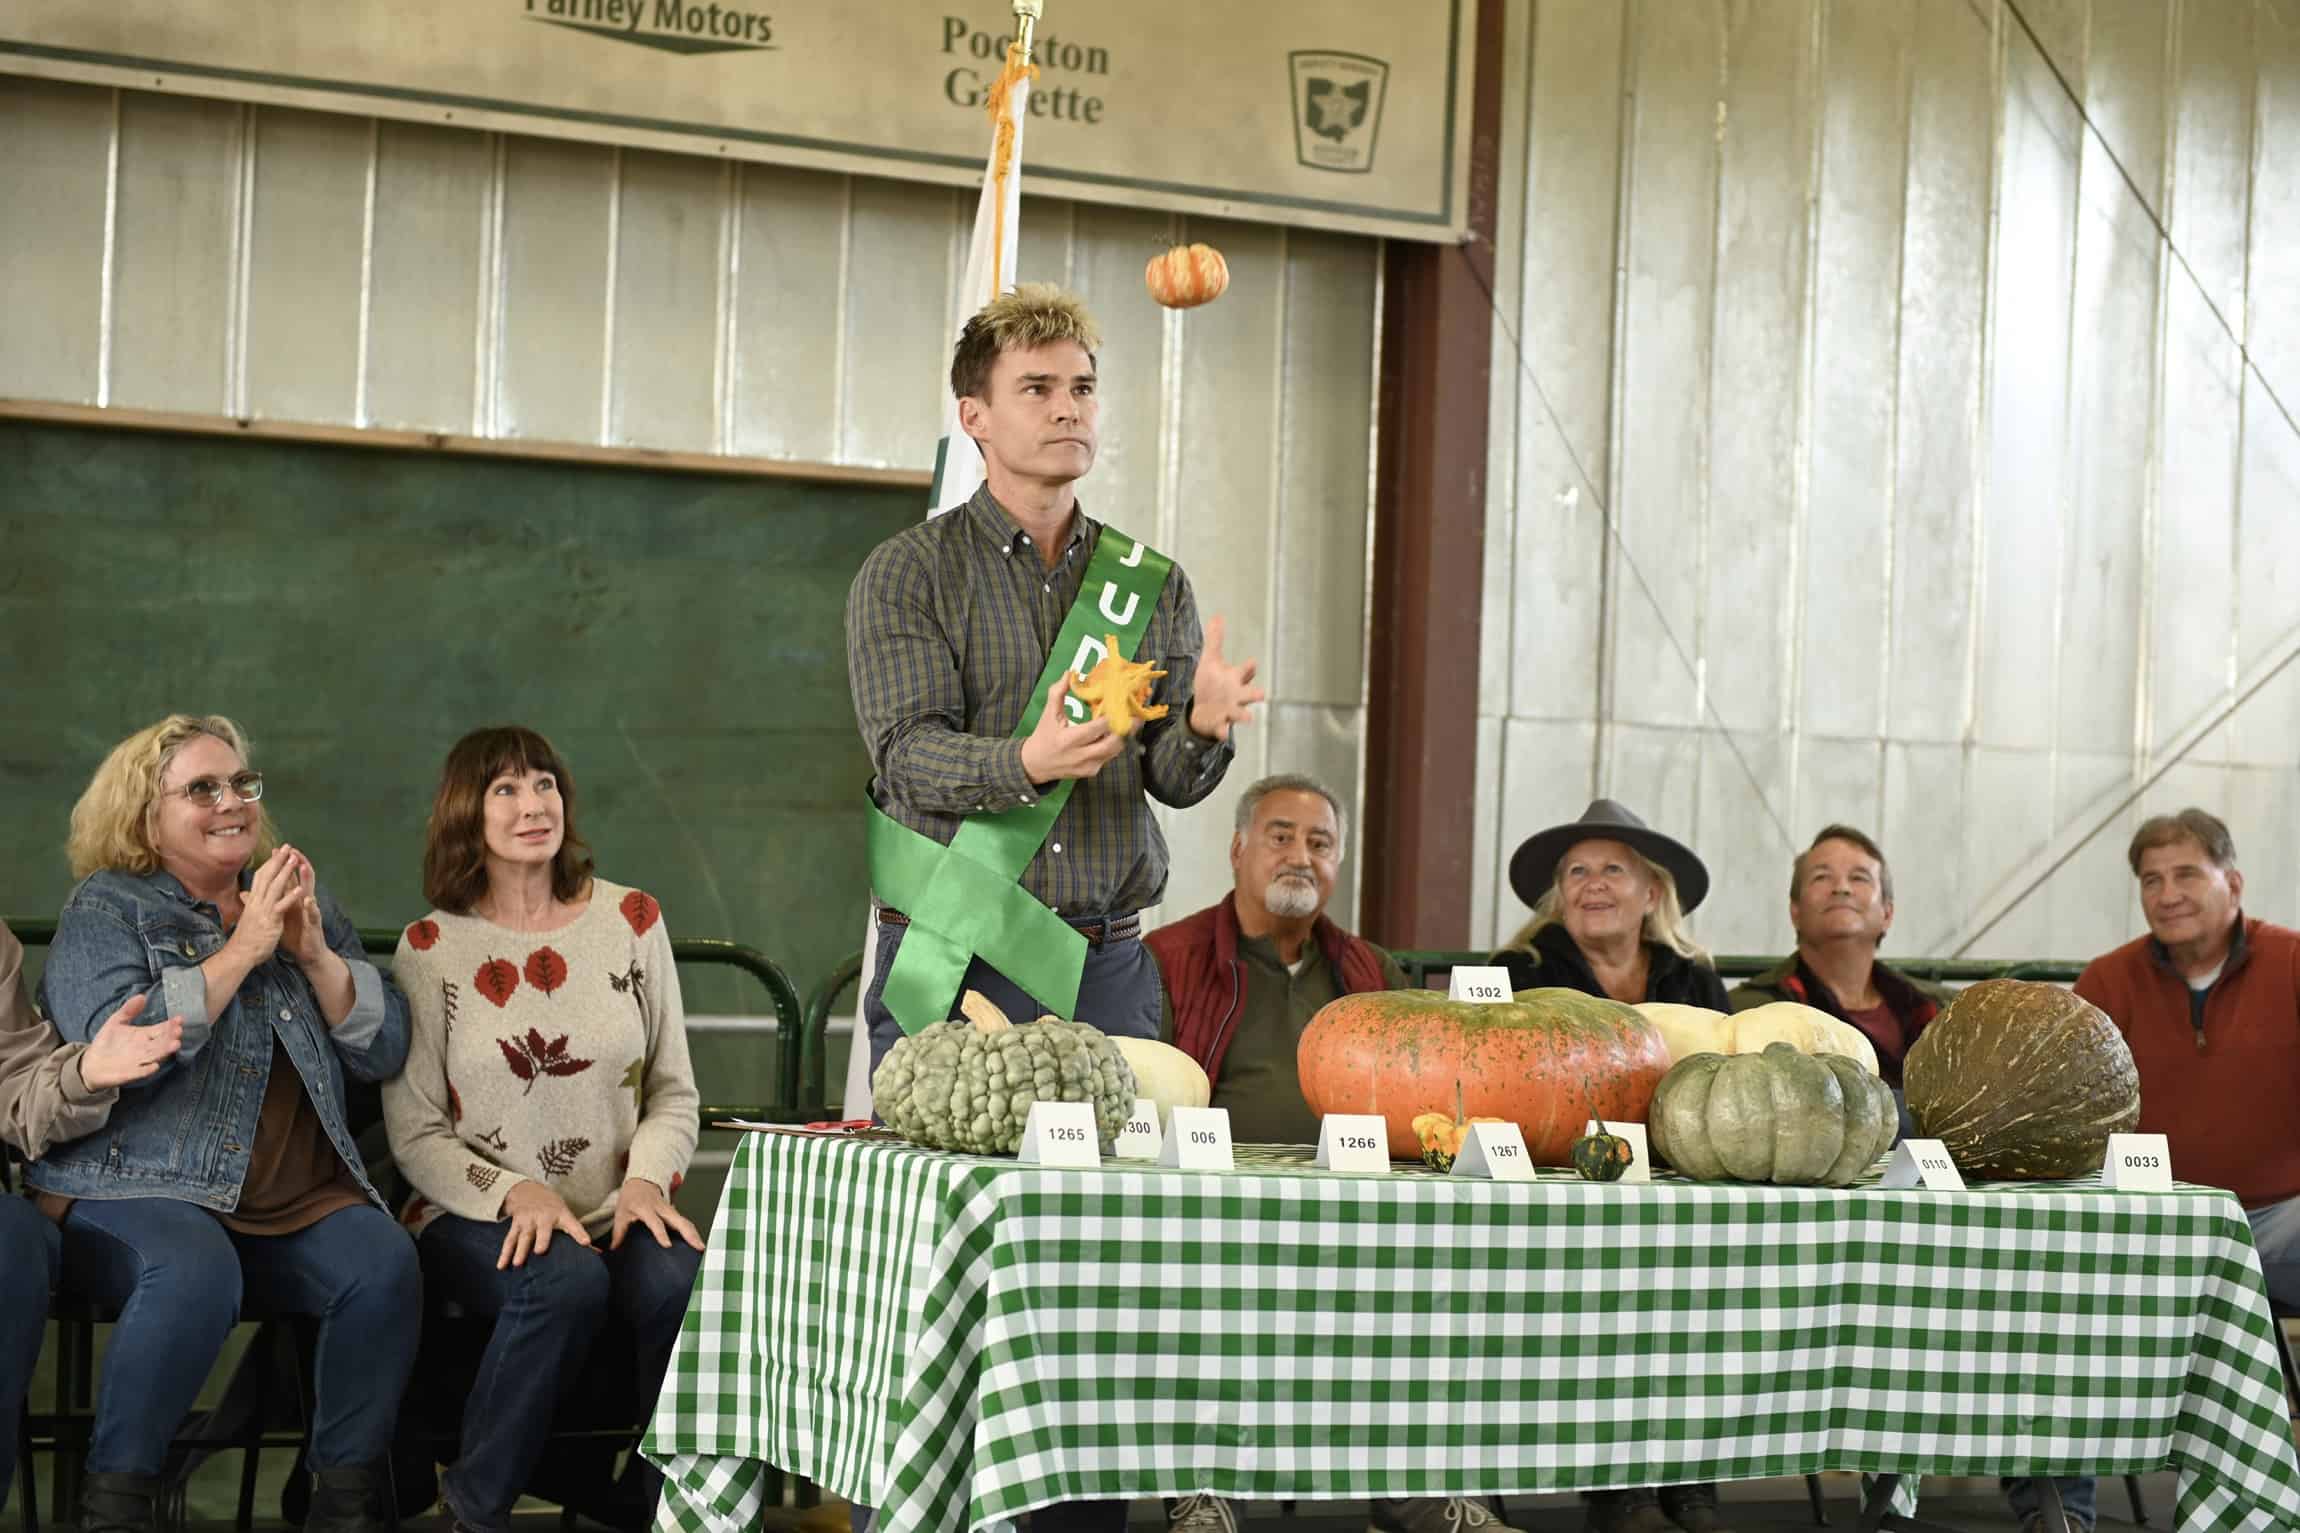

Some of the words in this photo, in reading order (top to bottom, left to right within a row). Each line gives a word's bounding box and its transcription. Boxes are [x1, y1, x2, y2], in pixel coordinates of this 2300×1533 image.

[655, 0, 771, 42] Motors
[945, 66, 1104, 124] Gette
[1468, 986, 1502, 998] 1302
[1048, 1128, 1085, 1141] 1265
[1191, 1131, 1216, 1145] 006
[1339, 1136, 1376, 1149] 1266
[1491, 1145, 1518, 1157] 1267
[2124, 1155, 2160, 1168] 0033
